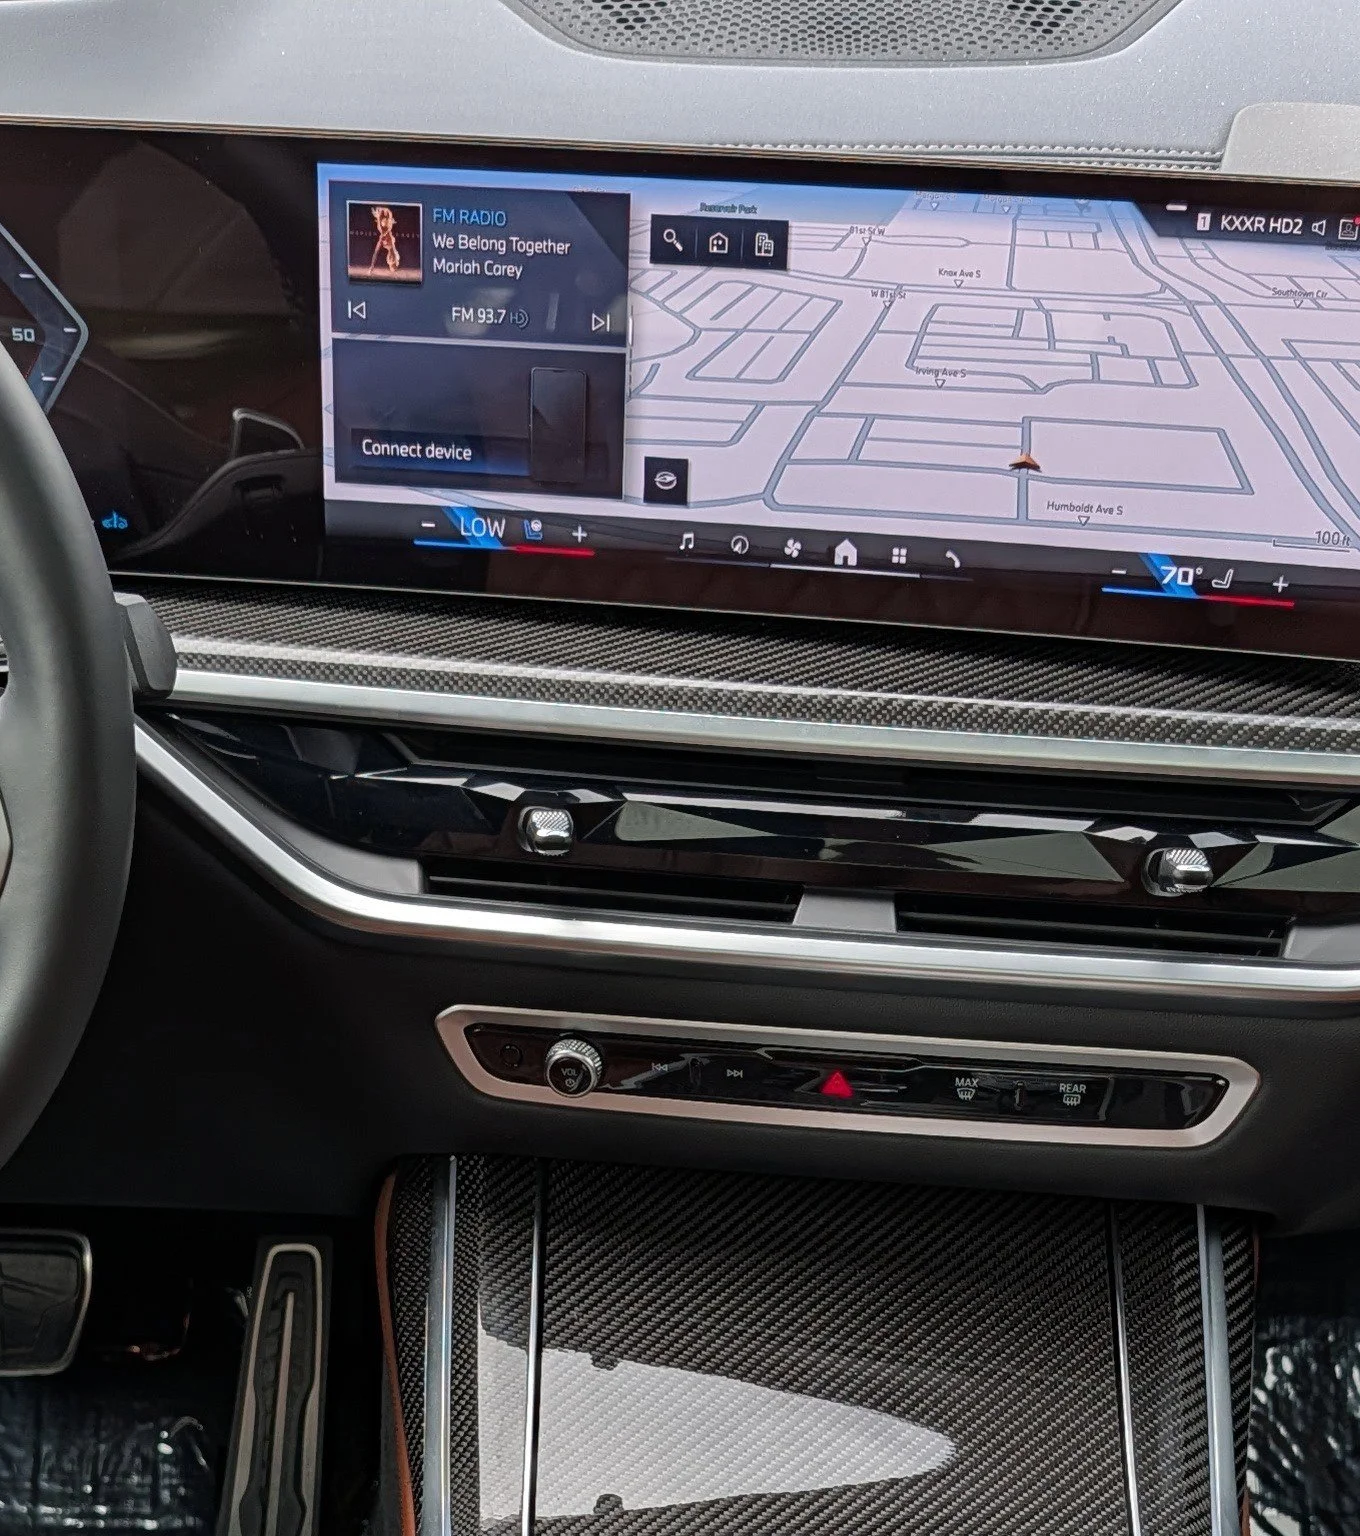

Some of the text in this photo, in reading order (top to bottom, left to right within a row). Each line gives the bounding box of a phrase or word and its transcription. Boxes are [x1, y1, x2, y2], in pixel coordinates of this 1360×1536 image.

[432, 208, 507, 227] FM RADIO
[1220, 214, 1267, 232] KXXR
[1269, 217, 1303, 234] HD2
[432, 232, 571, 257] We Belong Together
[432, 257, 524, 280] Mariah Carey
[959, 269, 974, 278] Ave
[975, 270, 982, 279] S
[451, 307, 475, 323] FM
[476, 307, 507, 325] 93.7
[11, 327, 36, 342] 50
[361, 438, 473, 462] Connect device
[1046, 499, 1124, 516] Humboldt Ave S
[459, 517, 507, 539] LOW
[1315, 530, 1341, 546] 100
[560, 1067, 578, 1077] VOL
[954, 1077, 980, 1088] MAX
[1059, 1083, 1087, 1094] REAR
